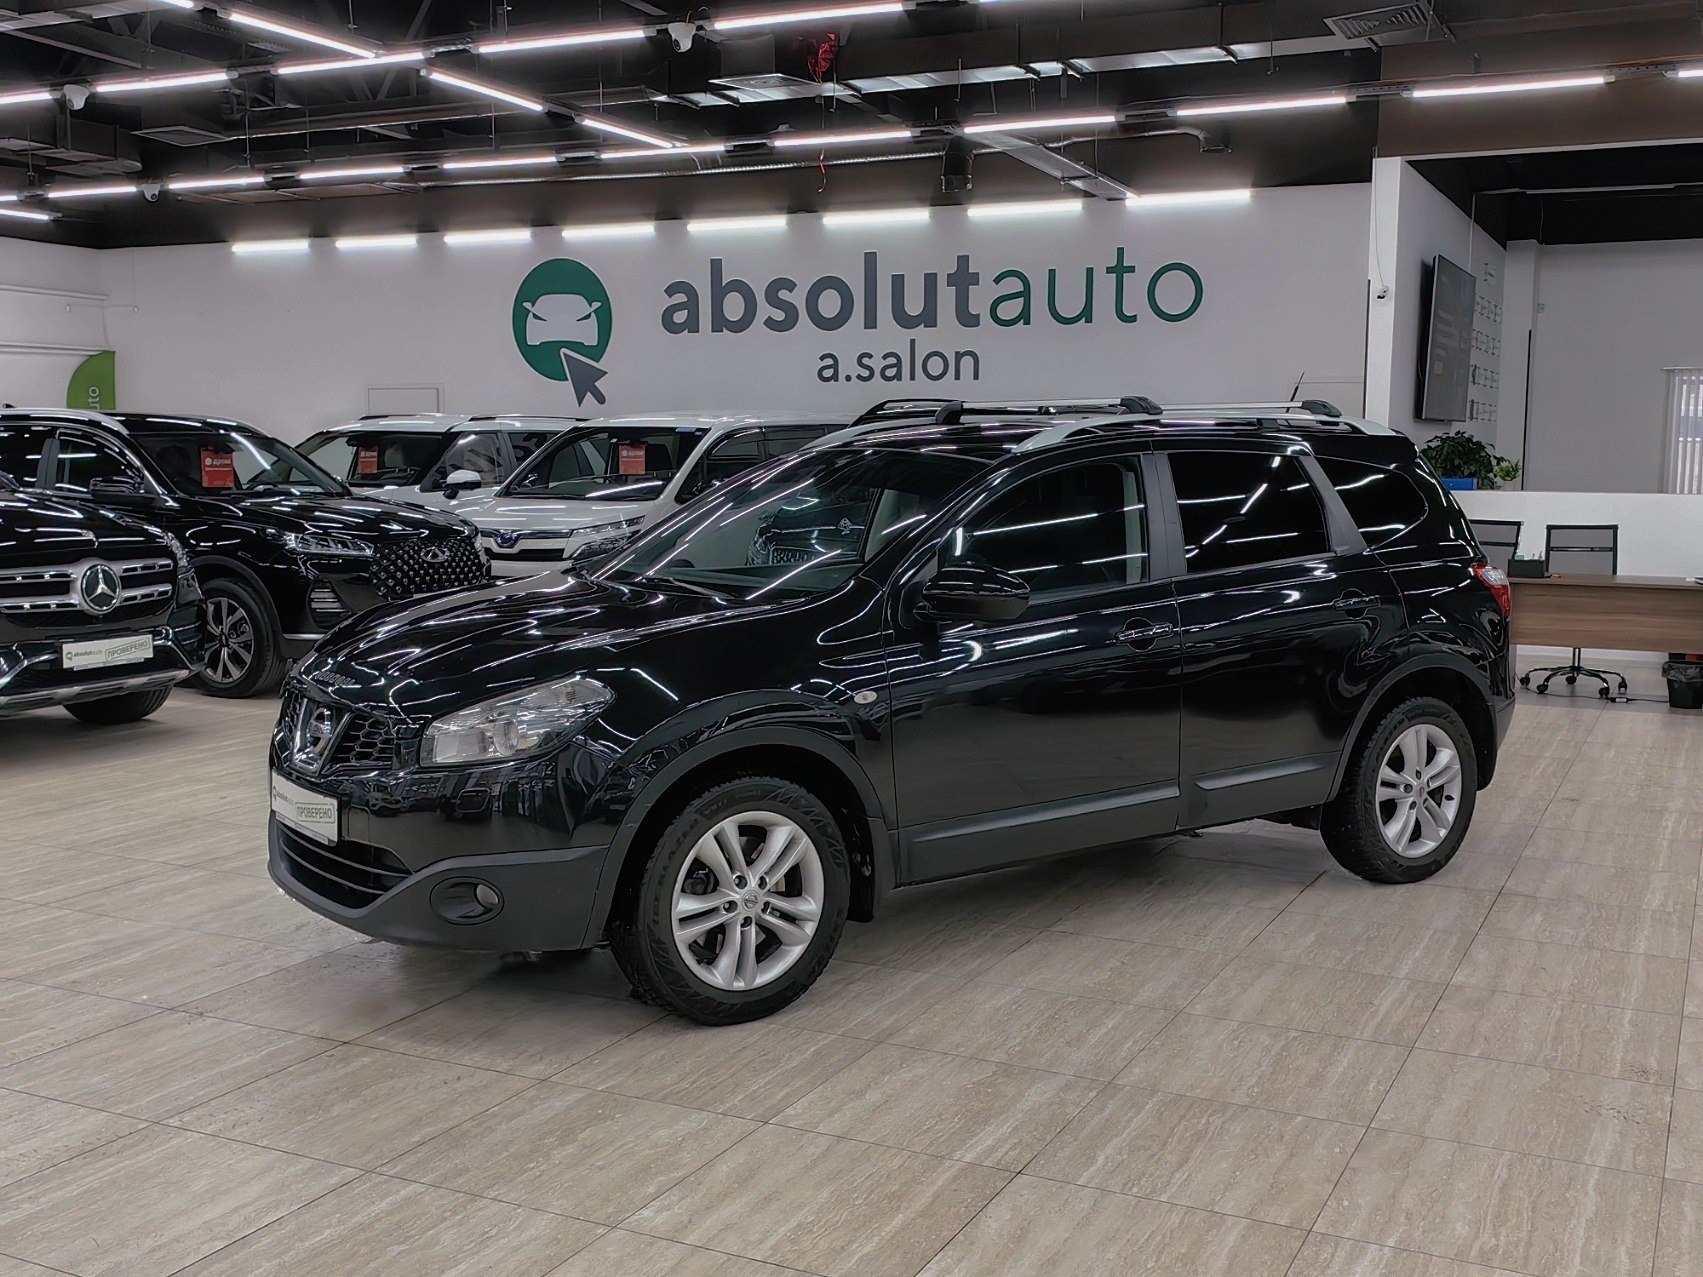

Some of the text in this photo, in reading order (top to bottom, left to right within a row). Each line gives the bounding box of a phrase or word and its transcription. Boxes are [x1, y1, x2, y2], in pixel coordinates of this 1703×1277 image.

[662, 247, 1203, 334] absolutauto
[817, 338, 979, 382] a.salon
[107, 640, 148, 658] ПРОВЕРЕНО
